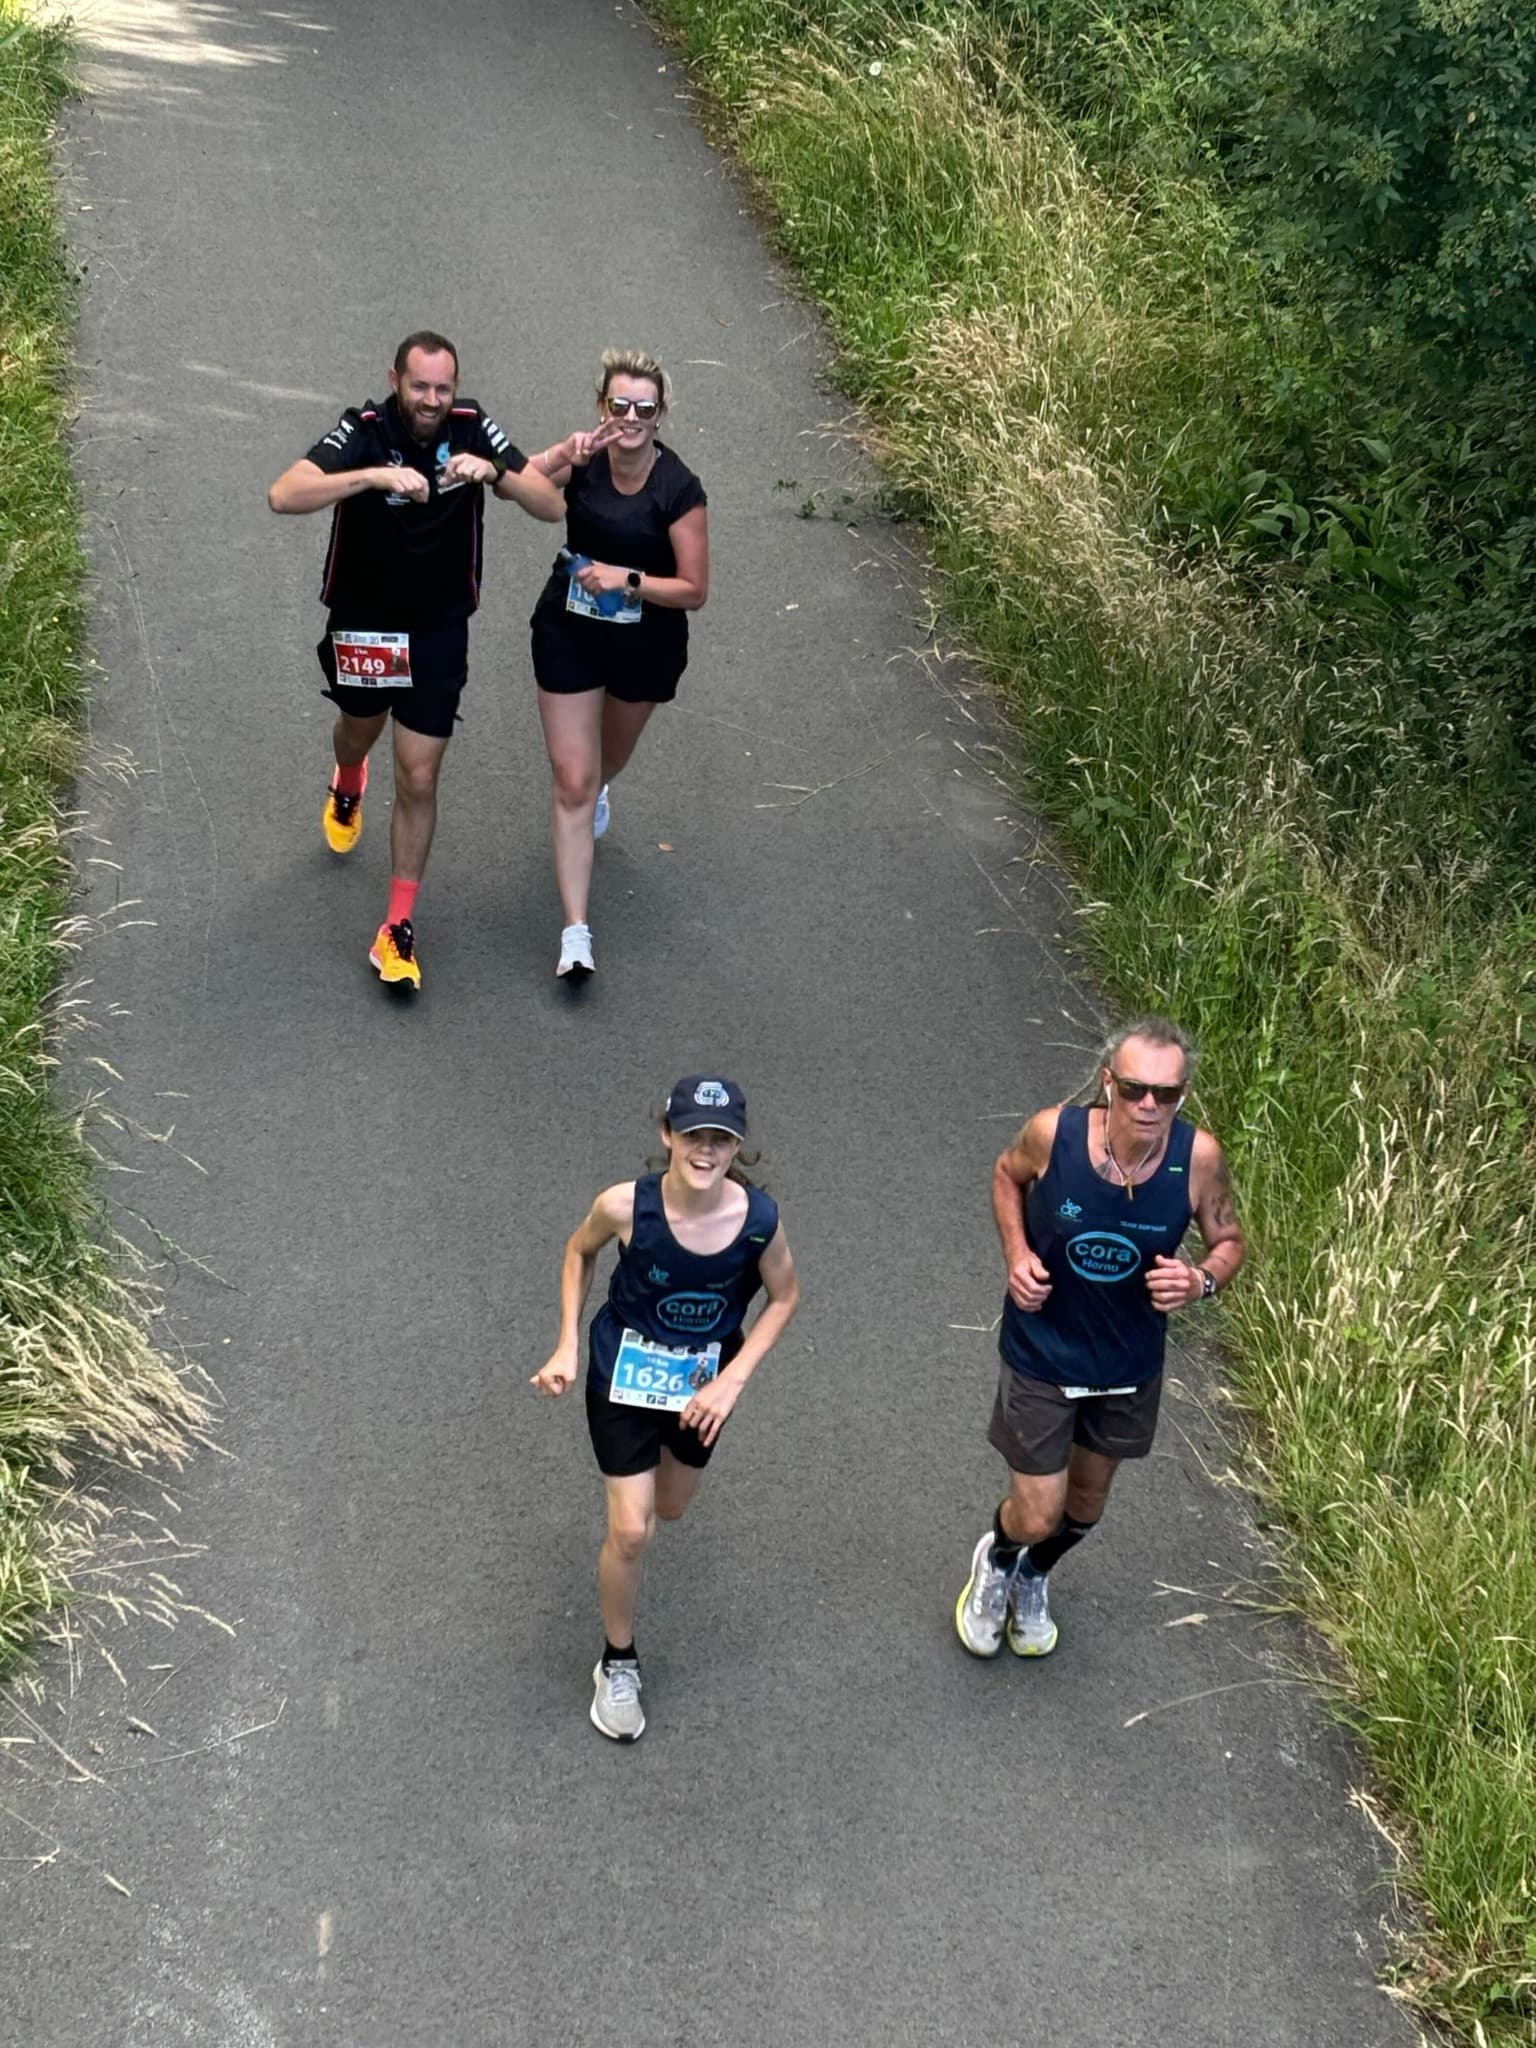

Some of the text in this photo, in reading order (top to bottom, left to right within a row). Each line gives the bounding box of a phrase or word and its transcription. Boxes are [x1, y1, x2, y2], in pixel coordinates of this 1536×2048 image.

[340, 655, 386, 675] 2149
[1075, 1242, 1132, 1263] cora
[623, 1363, 685, 1392] 1626
